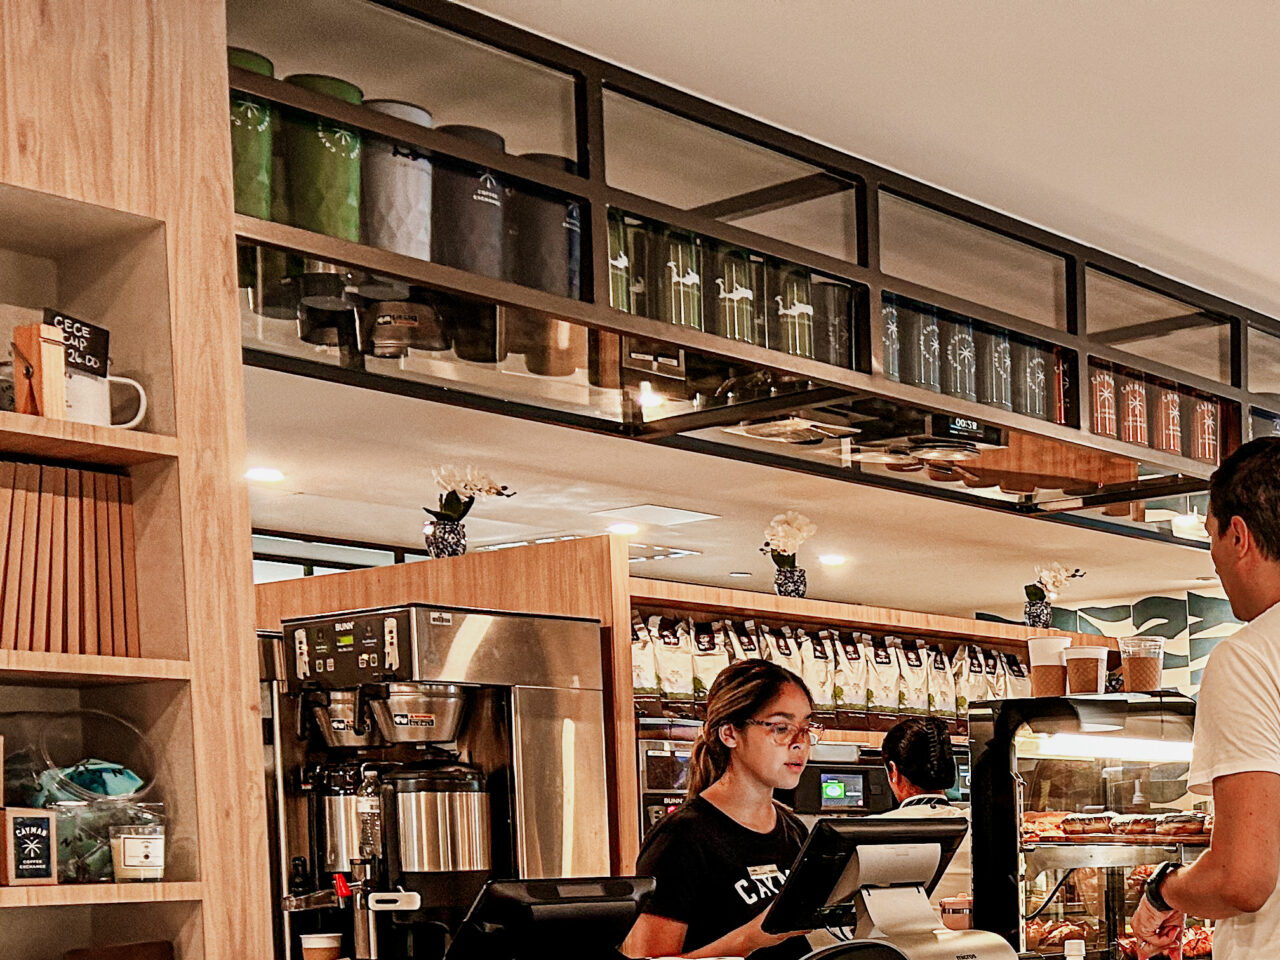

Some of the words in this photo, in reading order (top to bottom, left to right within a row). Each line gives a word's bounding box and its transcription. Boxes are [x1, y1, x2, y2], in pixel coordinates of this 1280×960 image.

[54, 316, 90, 338] CECE
[62, 333, 87, 351] CUP
[334, 621, 354, 632] BUNN
[15, 826, 48, 837] CAYMAN
[734, 869, 791, 905] CAYM
[956, 953, 977, 960] micros
